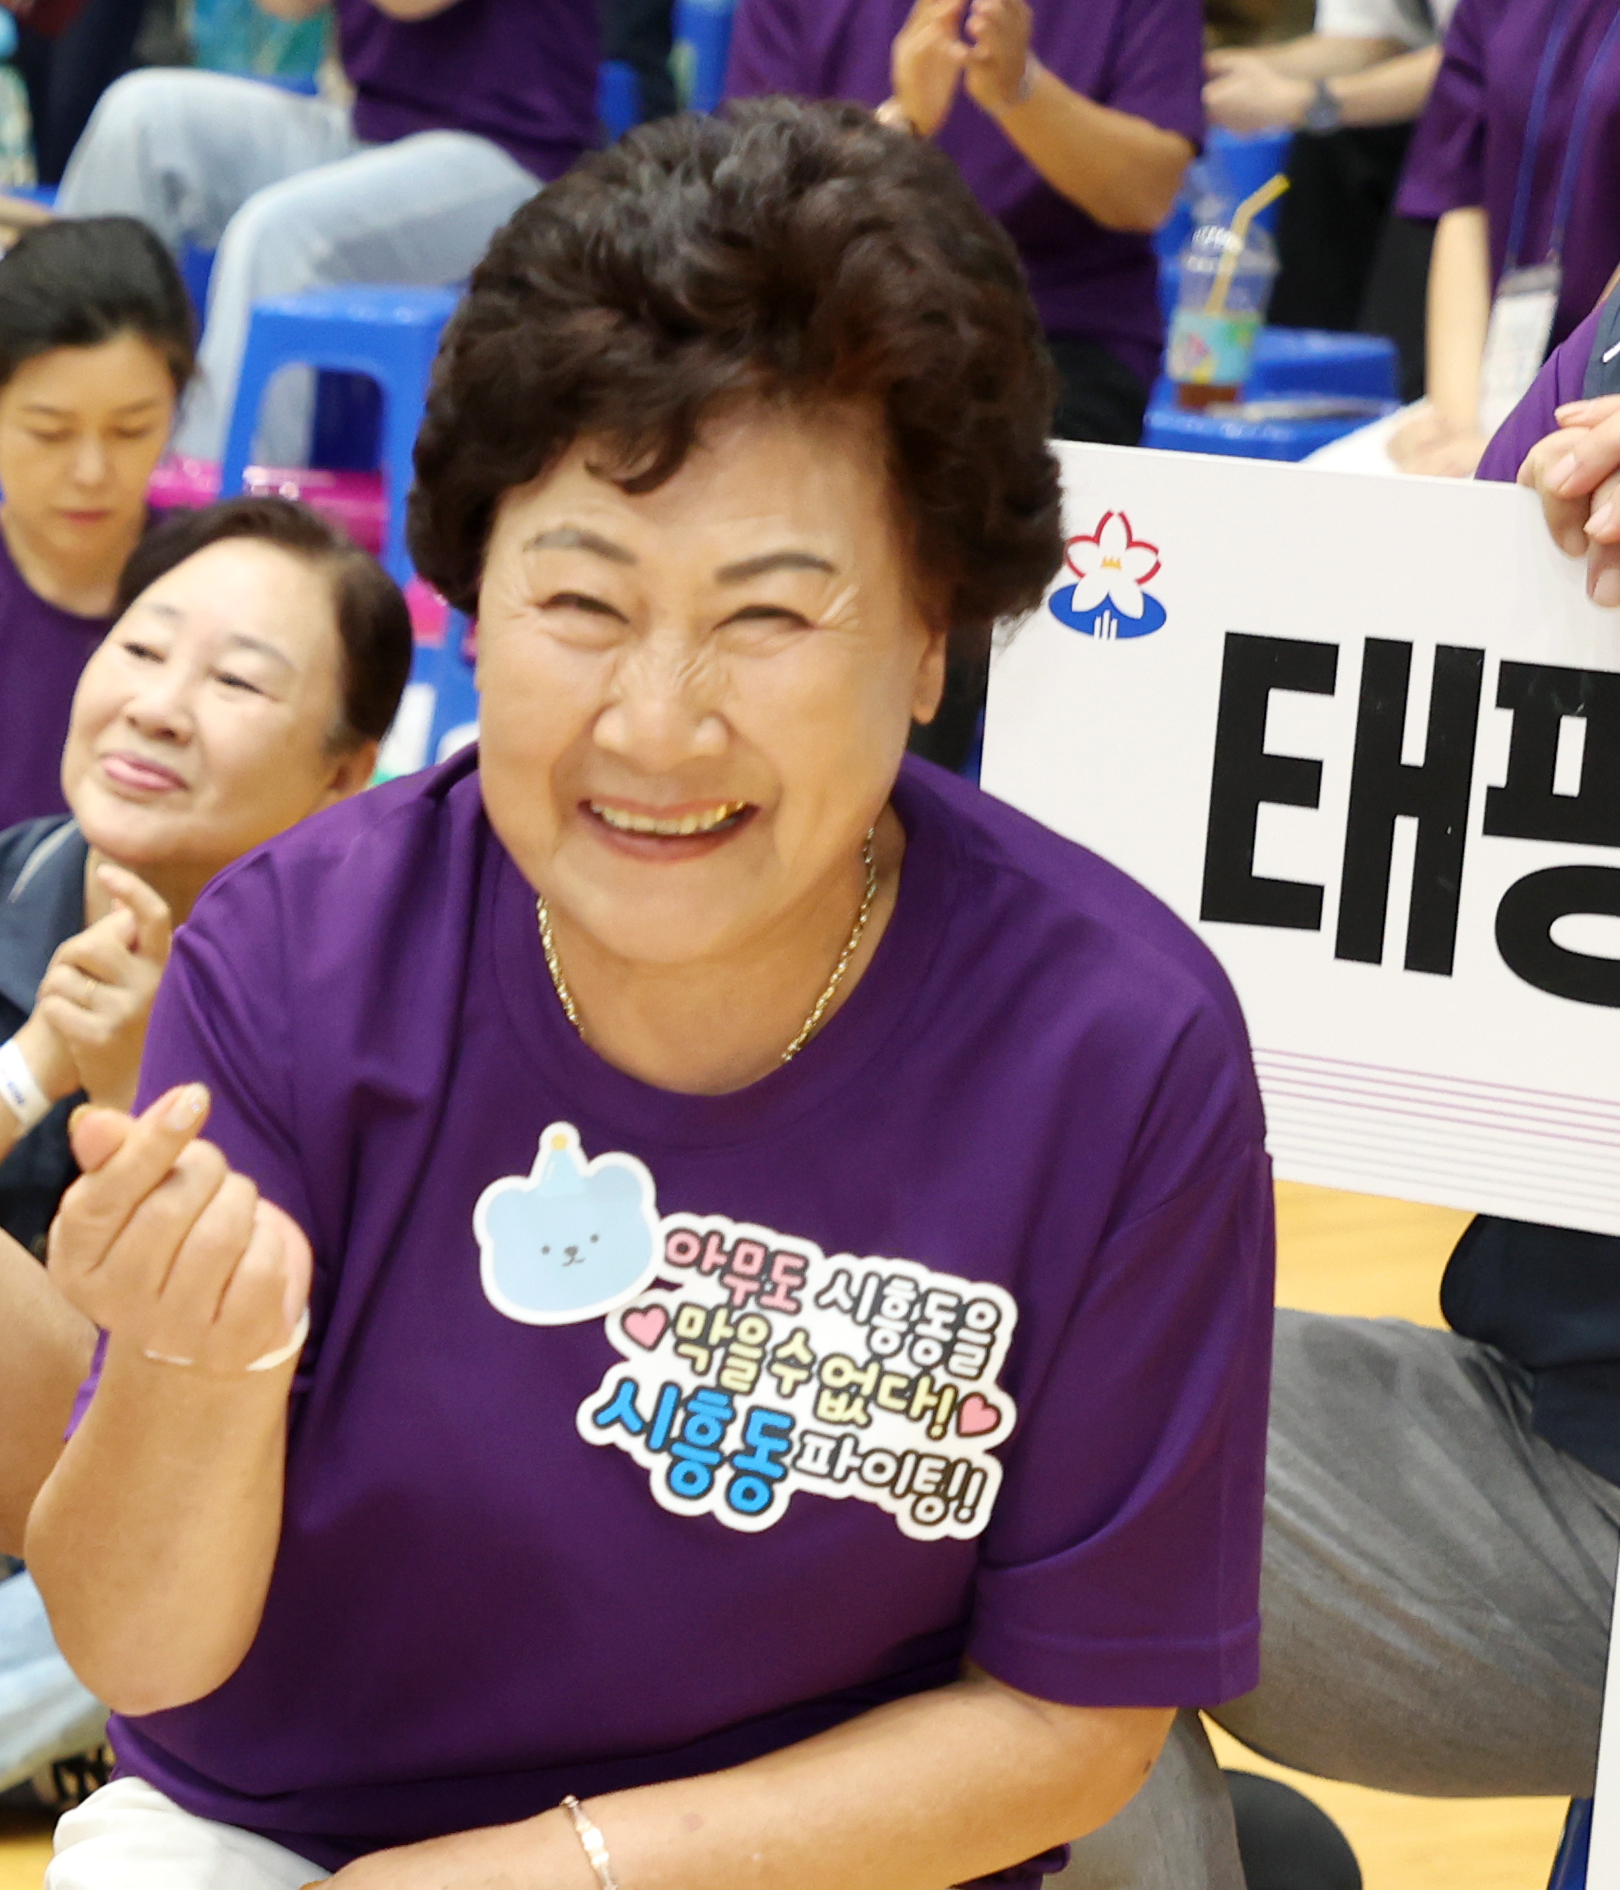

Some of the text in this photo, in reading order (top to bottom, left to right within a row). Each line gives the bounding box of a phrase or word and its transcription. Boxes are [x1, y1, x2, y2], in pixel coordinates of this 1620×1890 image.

[664, 1227, 1002, 1381] 아무도 시흥동을
[592, 1376, 989, 1527] 시흥동 파이팅!
